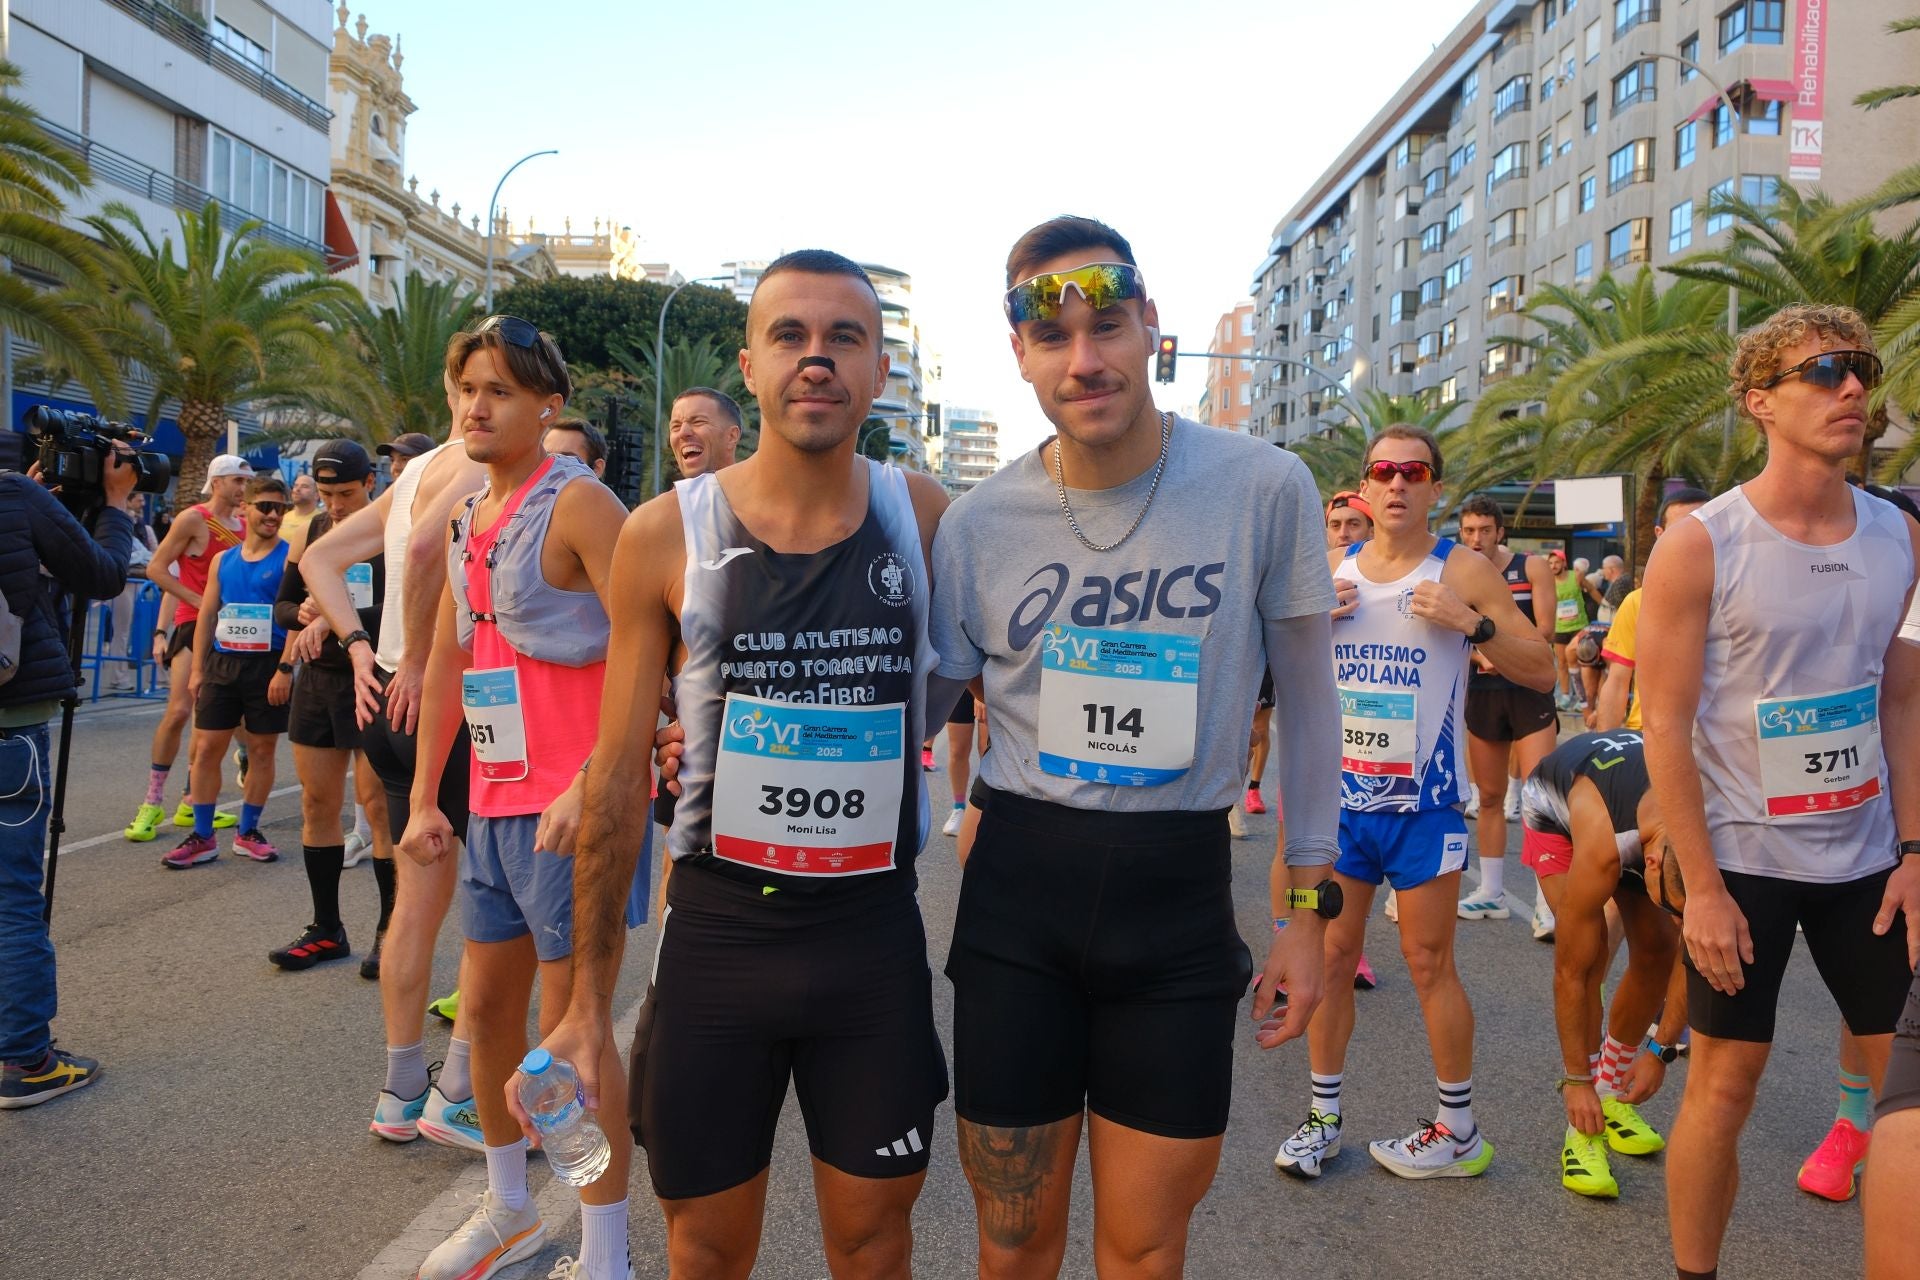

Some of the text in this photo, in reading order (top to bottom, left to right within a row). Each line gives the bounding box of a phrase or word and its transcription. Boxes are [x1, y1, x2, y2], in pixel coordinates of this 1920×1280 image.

[1810, 562, 1849, 573] FUSION
[227, 626, 258, 635] 3260
[733, 627, 903, 652] CLUB ATLETISMO
[1071, 637, 1100, 661] VI
[1100, 640, 1147, 650] Gran Carrera
[1334, 644, 1426, 665] ATLETISMO
[720, 654, 912, 679] PUERTO TORREVIEJA
[1114, 663, 1143, 675] 2025
[1337, 662, 1421, 688] APOLANA
[1083, 703, 1145, 738] 114
[1795, 708, 1818, 725] VI
[1830, 718, 1848, 728] 2025
[467, 723, 496, 745] 051
[772, 721, 801, 745] VI
[803, 724, 848, 733] Gran Carrera
[1087, 740, 1137, 754] NICOLÁS
[1343, 728, 1390, 748] 3878
[816, 747, 843, 757] 2025
[1804, 744, 1860, 774] 3711
[1823, 774, 1850, 784] Gerben
[758, 784, 865, 819] 3908
[815, 825, 837, 835] Lisa
